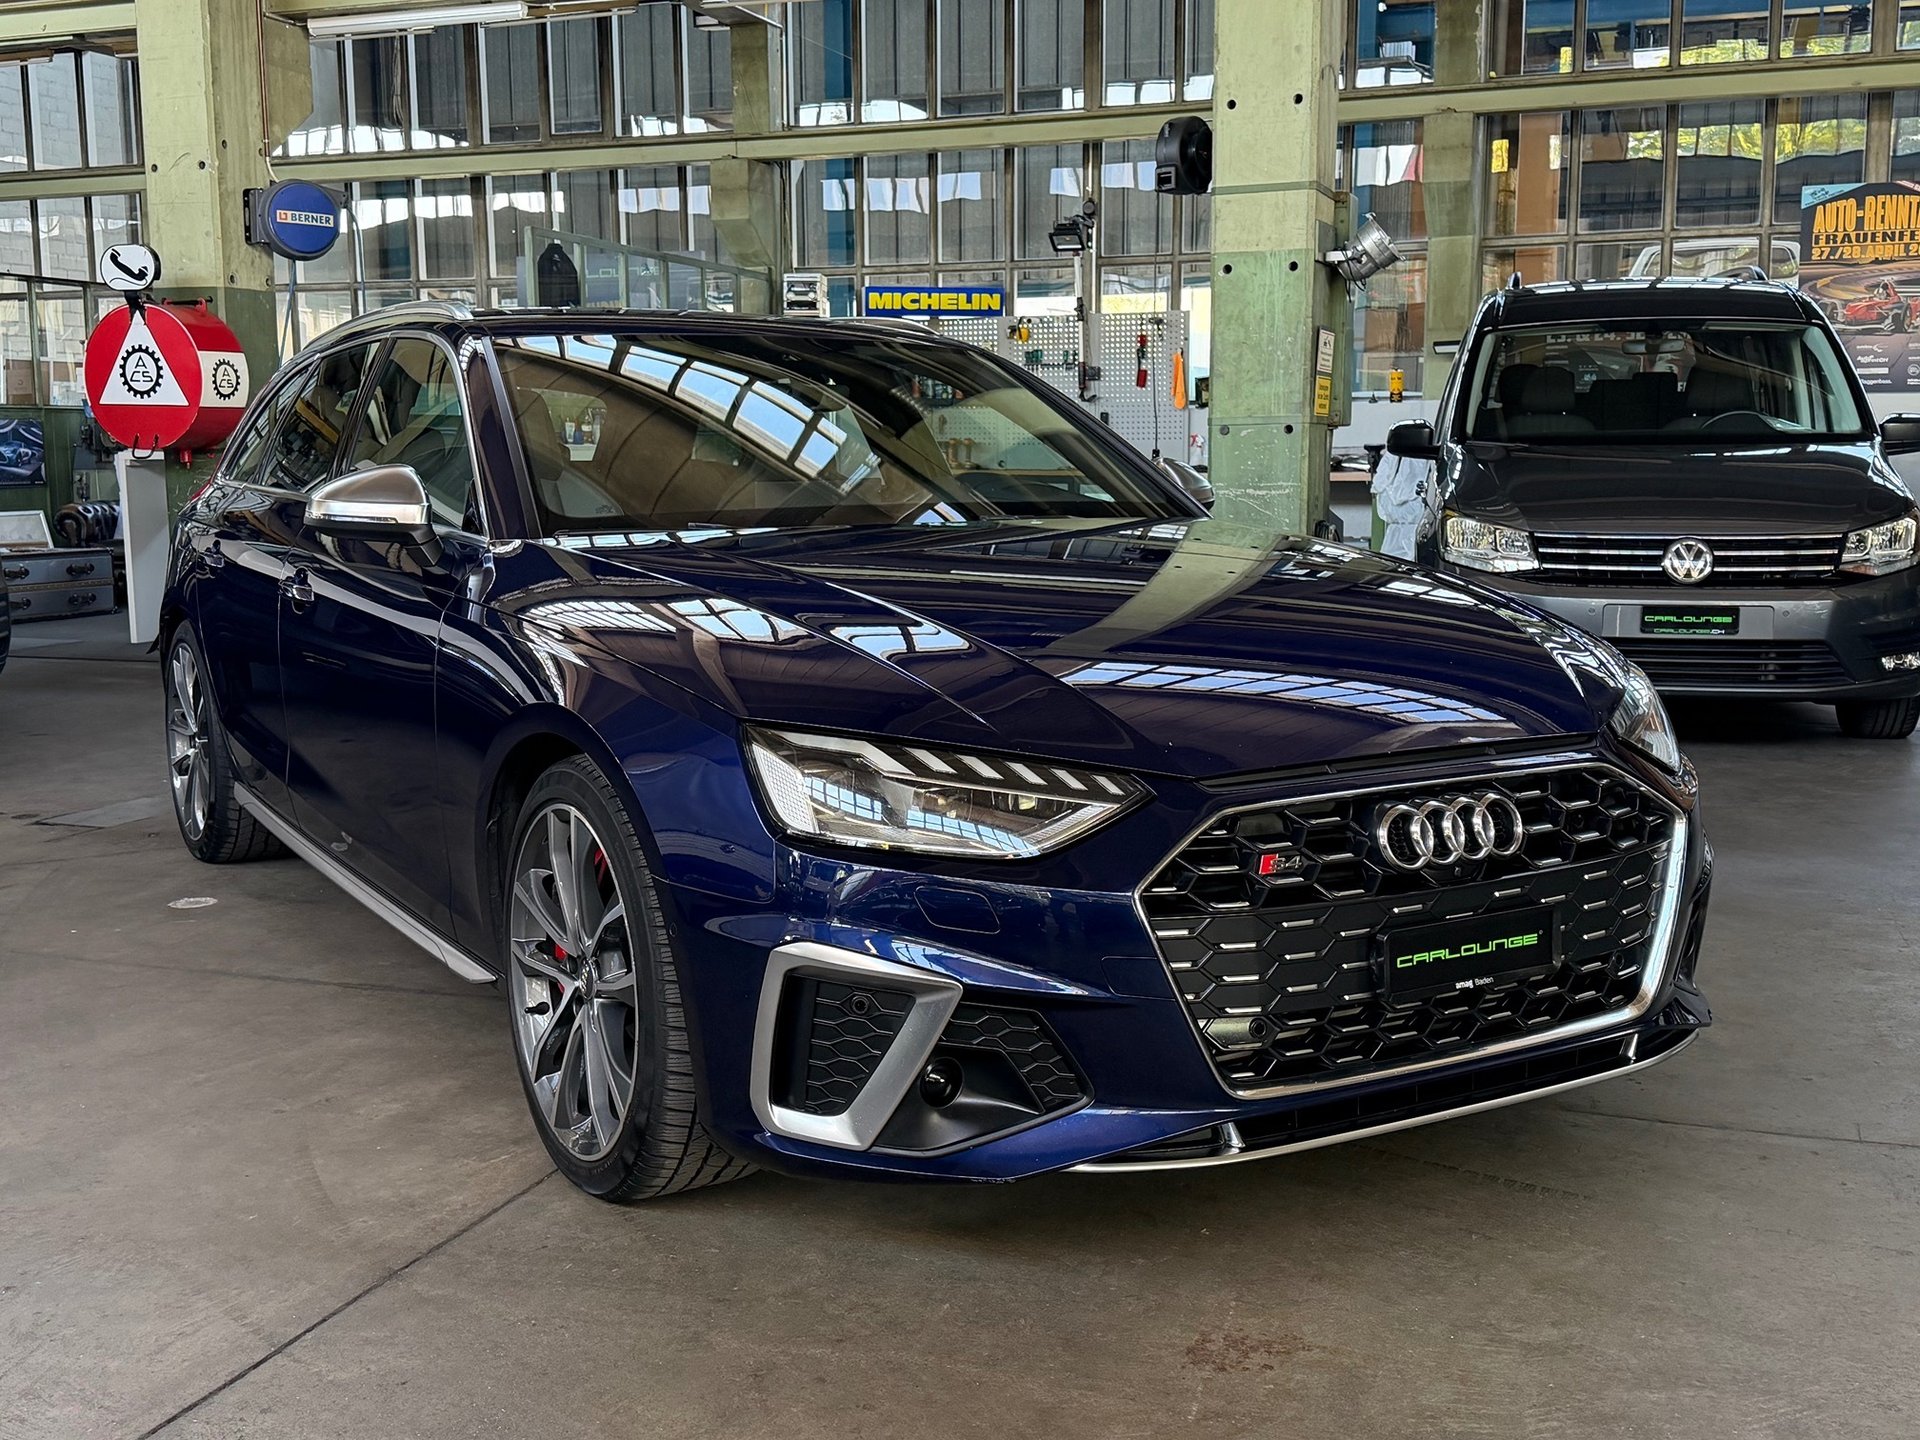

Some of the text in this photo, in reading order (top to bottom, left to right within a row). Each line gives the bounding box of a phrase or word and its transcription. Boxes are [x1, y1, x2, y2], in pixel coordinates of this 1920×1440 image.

[290, 212, 332, 226] BERNER
[868, 292, 1001, 310] MICHELIN
[1644, 615, 1733, 623] CARLOUNGE
[1270, 855, 1303, 870] S4
[1396, 933, 1538, 968] CARLOUNGE
[1455, 976, 1495, 990] amag Baden
